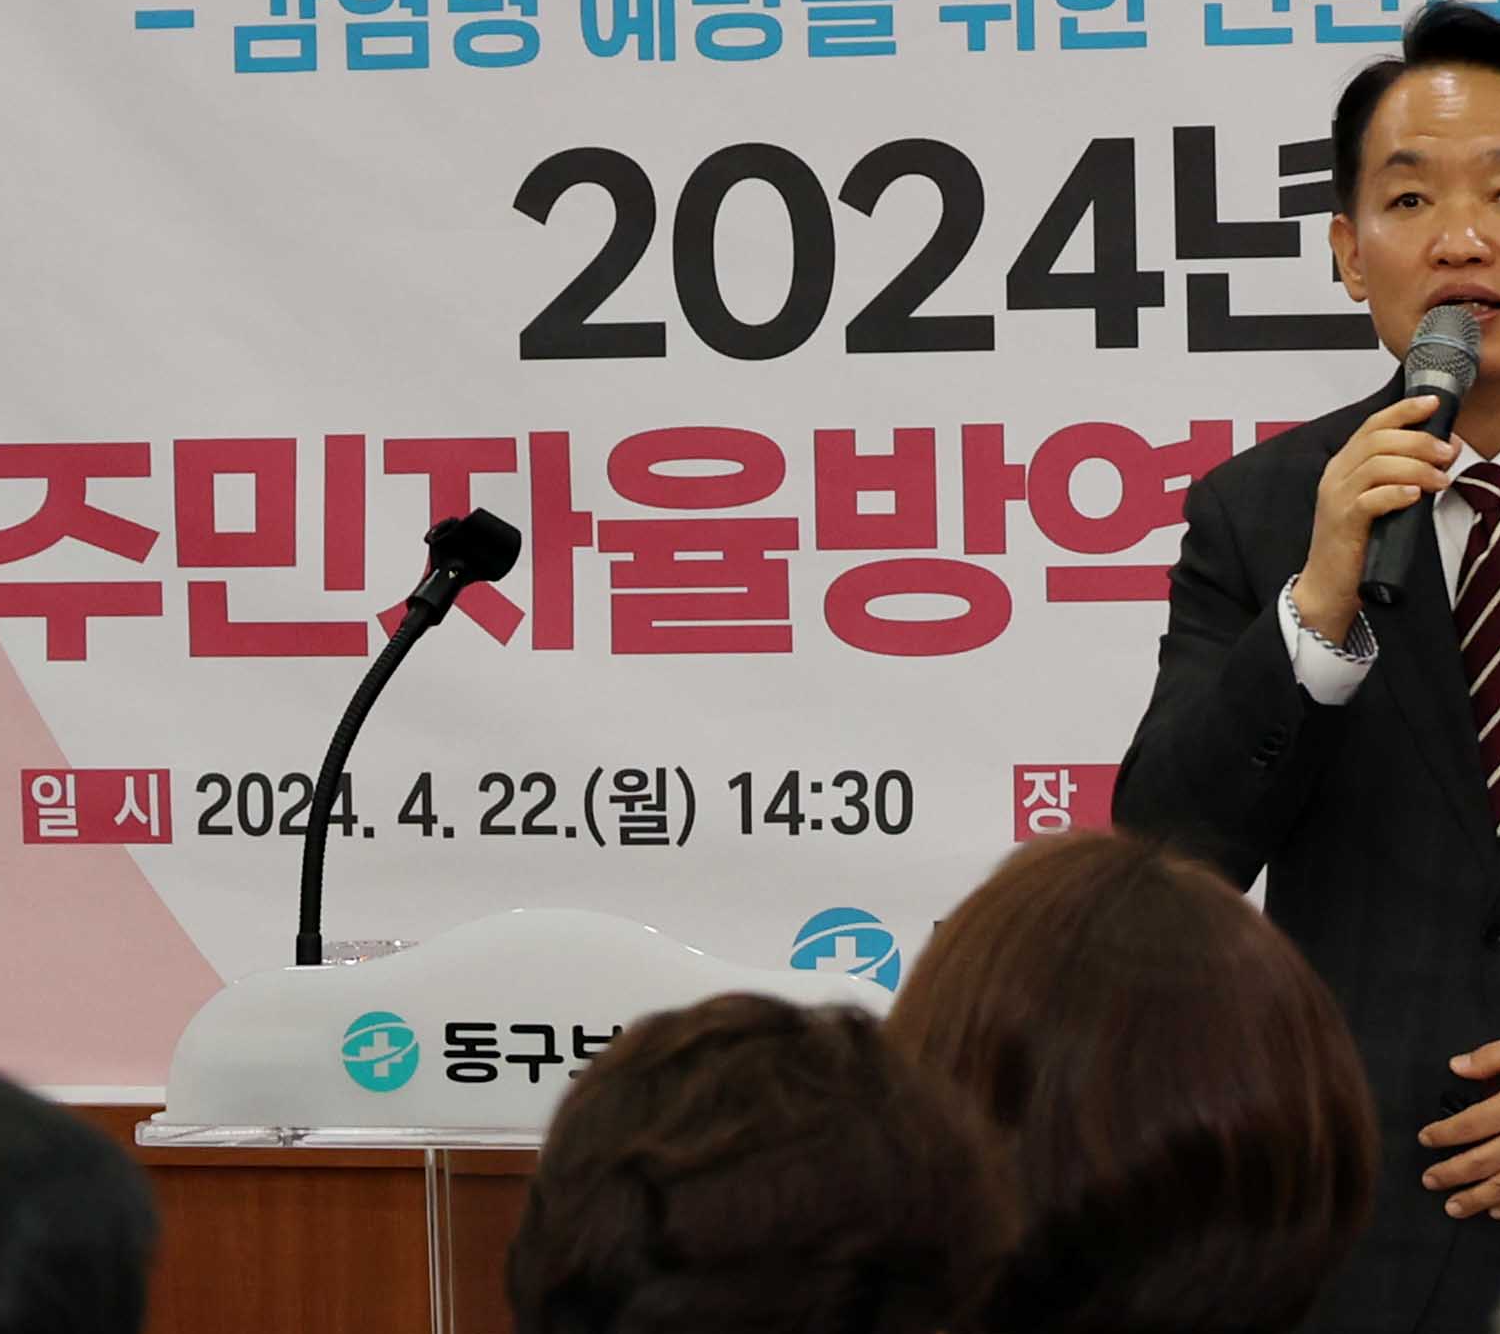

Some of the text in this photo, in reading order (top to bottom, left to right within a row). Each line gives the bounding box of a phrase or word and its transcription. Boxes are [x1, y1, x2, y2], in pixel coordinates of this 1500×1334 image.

[397, 770, 456, 839] 4.
[727, 770, 915, 836] 14:30
[443, 1022, 624, 1084] 동구보
